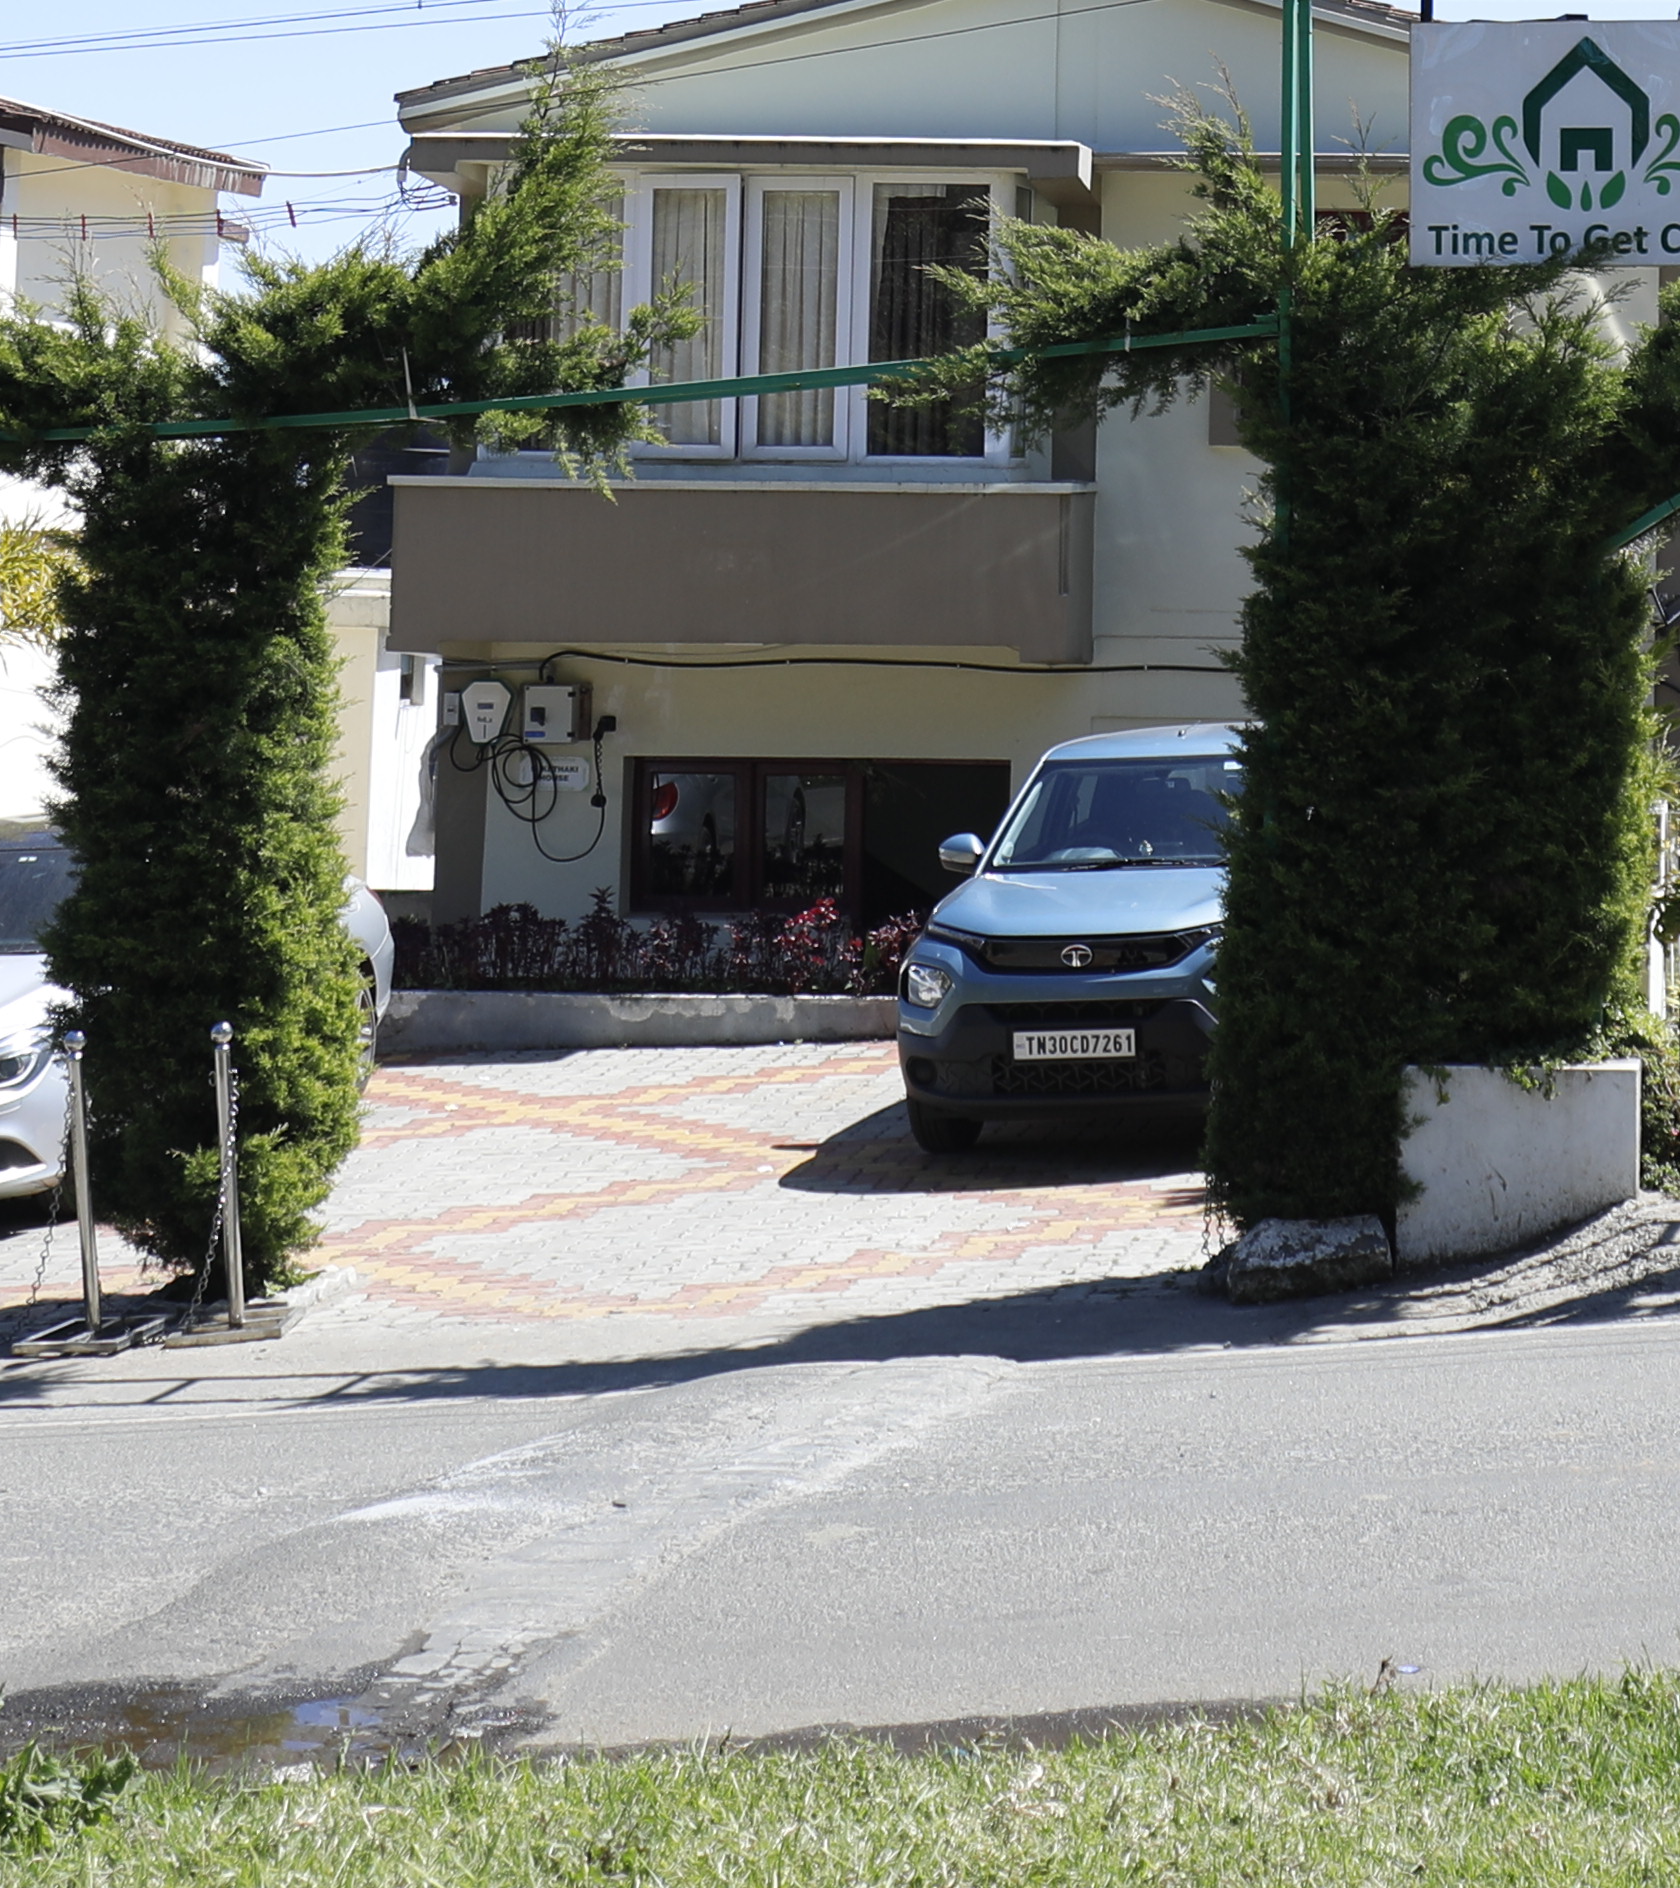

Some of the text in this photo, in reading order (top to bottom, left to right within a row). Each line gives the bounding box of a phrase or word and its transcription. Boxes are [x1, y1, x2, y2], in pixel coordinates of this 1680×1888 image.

[1427, 224, 1519, 256] Time
[1529, 224, 1571, 256] To
[1583, 224, 1650, 256] Get
